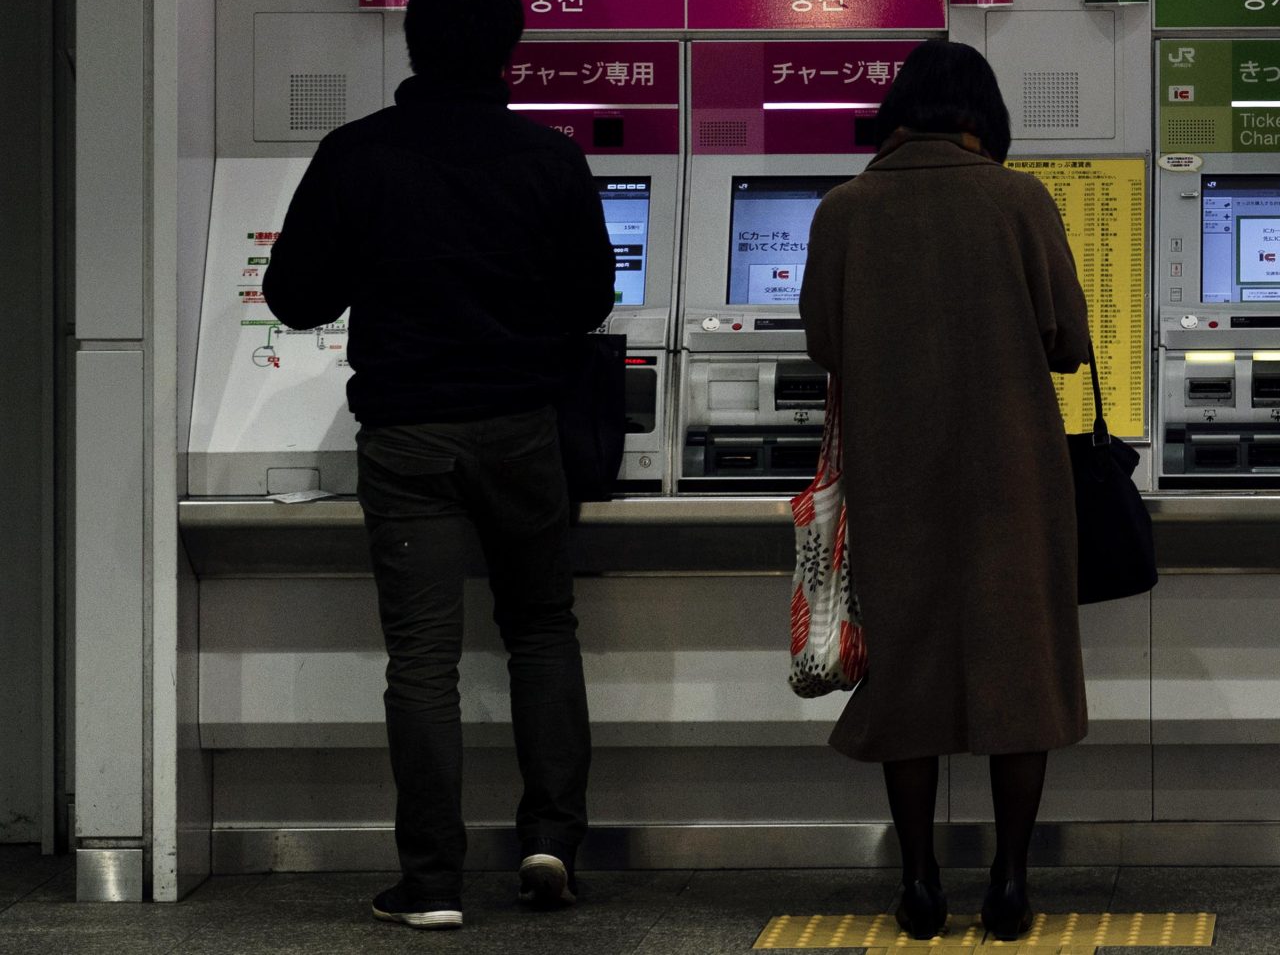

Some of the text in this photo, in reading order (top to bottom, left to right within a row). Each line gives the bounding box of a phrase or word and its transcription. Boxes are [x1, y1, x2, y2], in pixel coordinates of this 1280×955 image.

[1168, 47, 1195, 63] JR
[511, 60, 655, 87] チャージ専用
[738, 231, 790, 241] ICカードを
